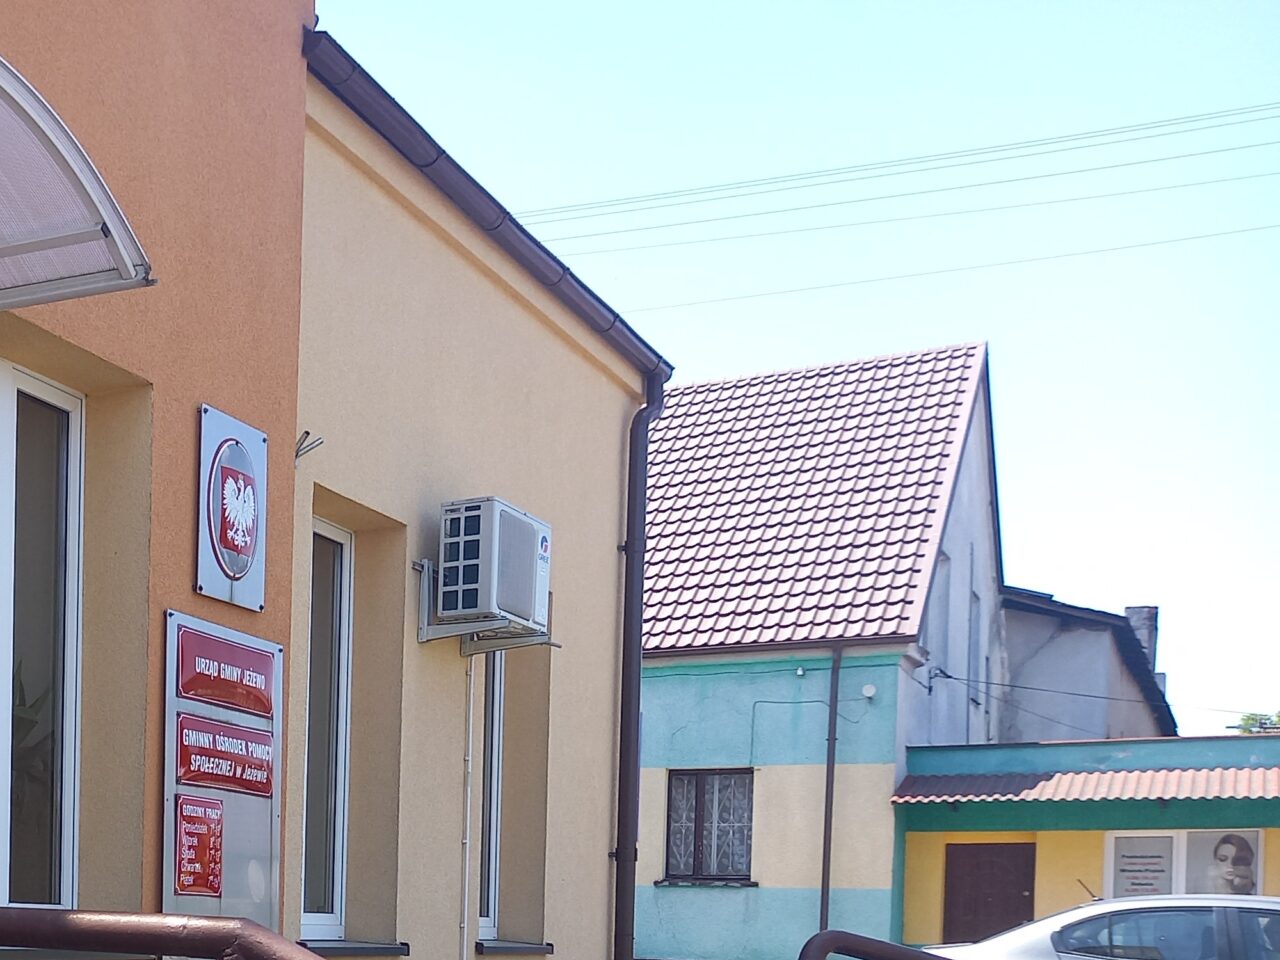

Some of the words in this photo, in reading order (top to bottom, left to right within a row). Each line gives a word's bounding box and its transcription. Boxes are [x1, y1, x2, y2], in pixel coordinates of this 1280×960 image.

[195, 656, 219, 681] URZĄD
[220, 662, 242, 683] GMINY
[242, 667, 266, 690] JEŻEWO
[182, 728, 215, 749] GMINNY
[215, 731, 247, 756] OŚRODEK
[248, 741, 273, 762] POMOCY
[190, 754, 235, 776] SPOŁECZNEJ
[242, 764, 268, 784] Jeżewie
